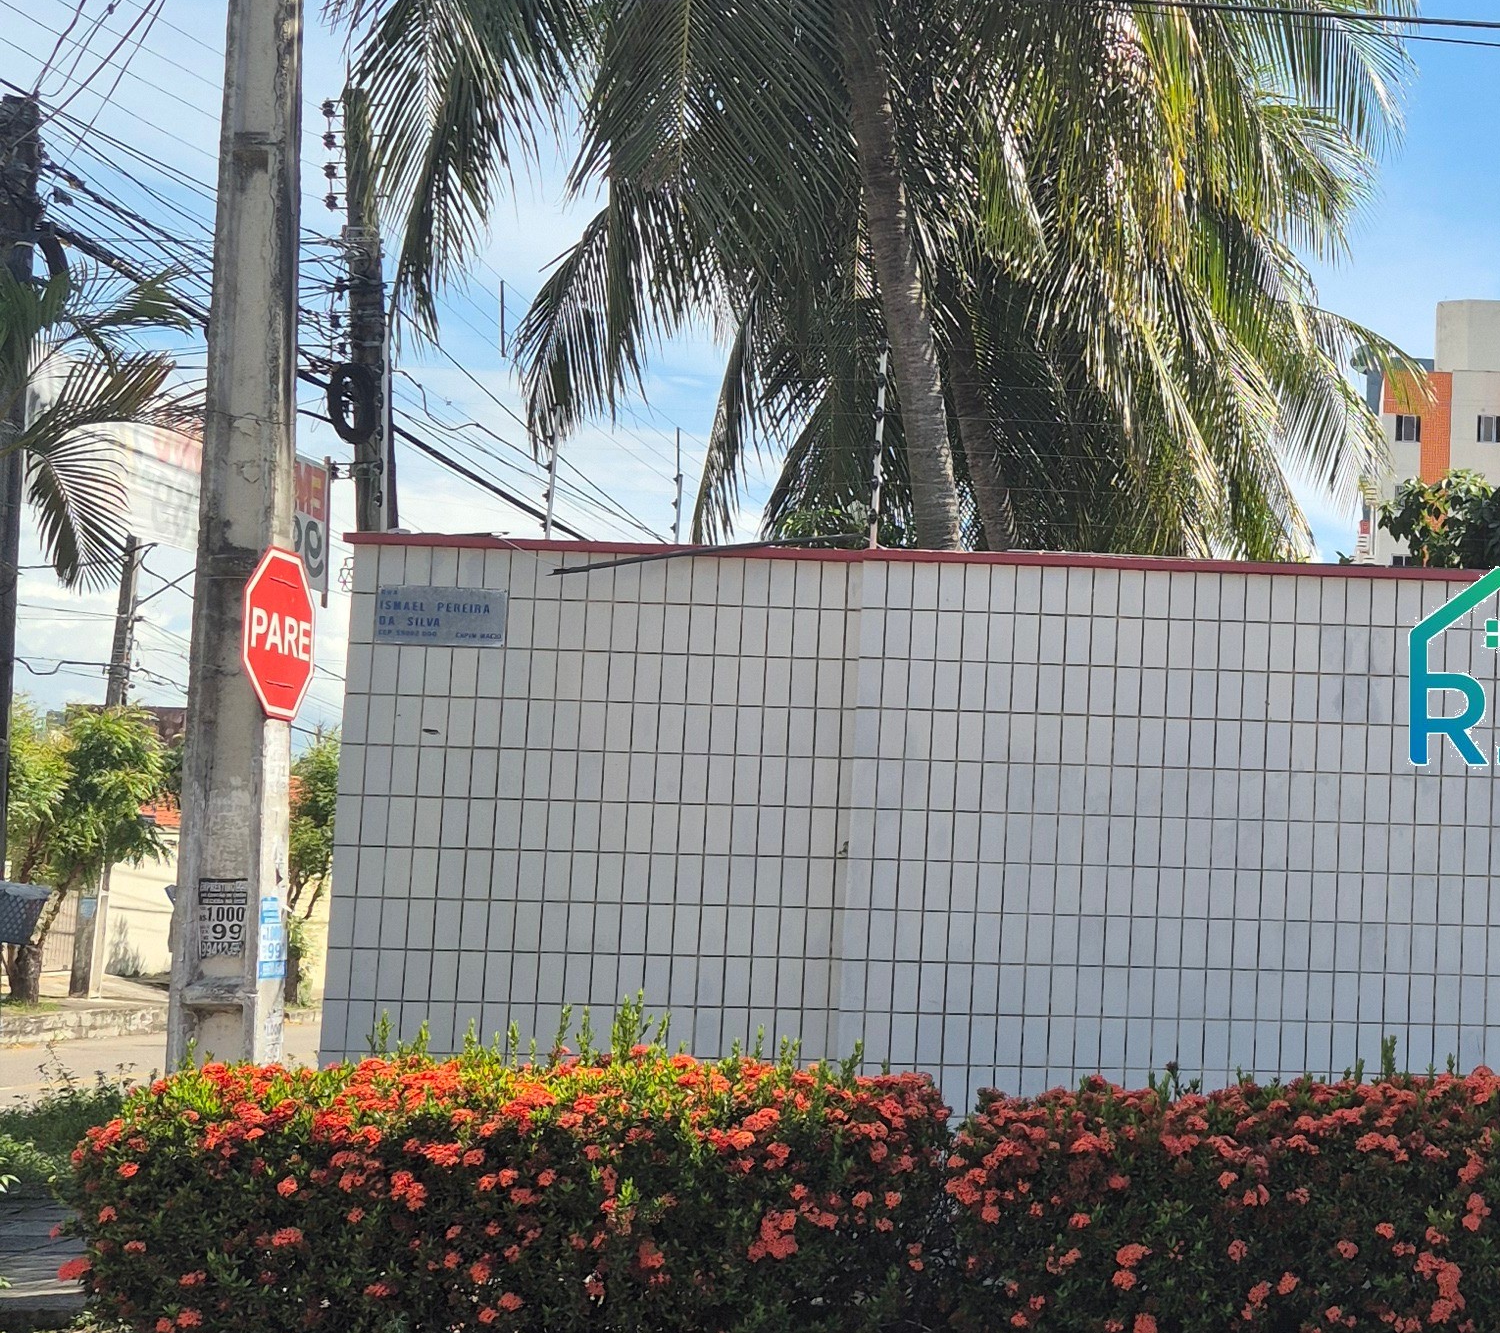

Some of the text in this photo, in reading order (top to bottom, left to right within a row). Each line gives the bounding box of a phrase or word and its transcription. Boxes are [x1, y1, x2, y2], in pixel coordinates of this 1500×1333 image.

[379, 600, 490, 614] ISMAEL PEREIRA
[378, 615, 440, 627] DA SILVA
[251, 606, 311, 662] PARE
[207, 906, 245, 922] 1.000
[211, 923, 242, 940] 99
